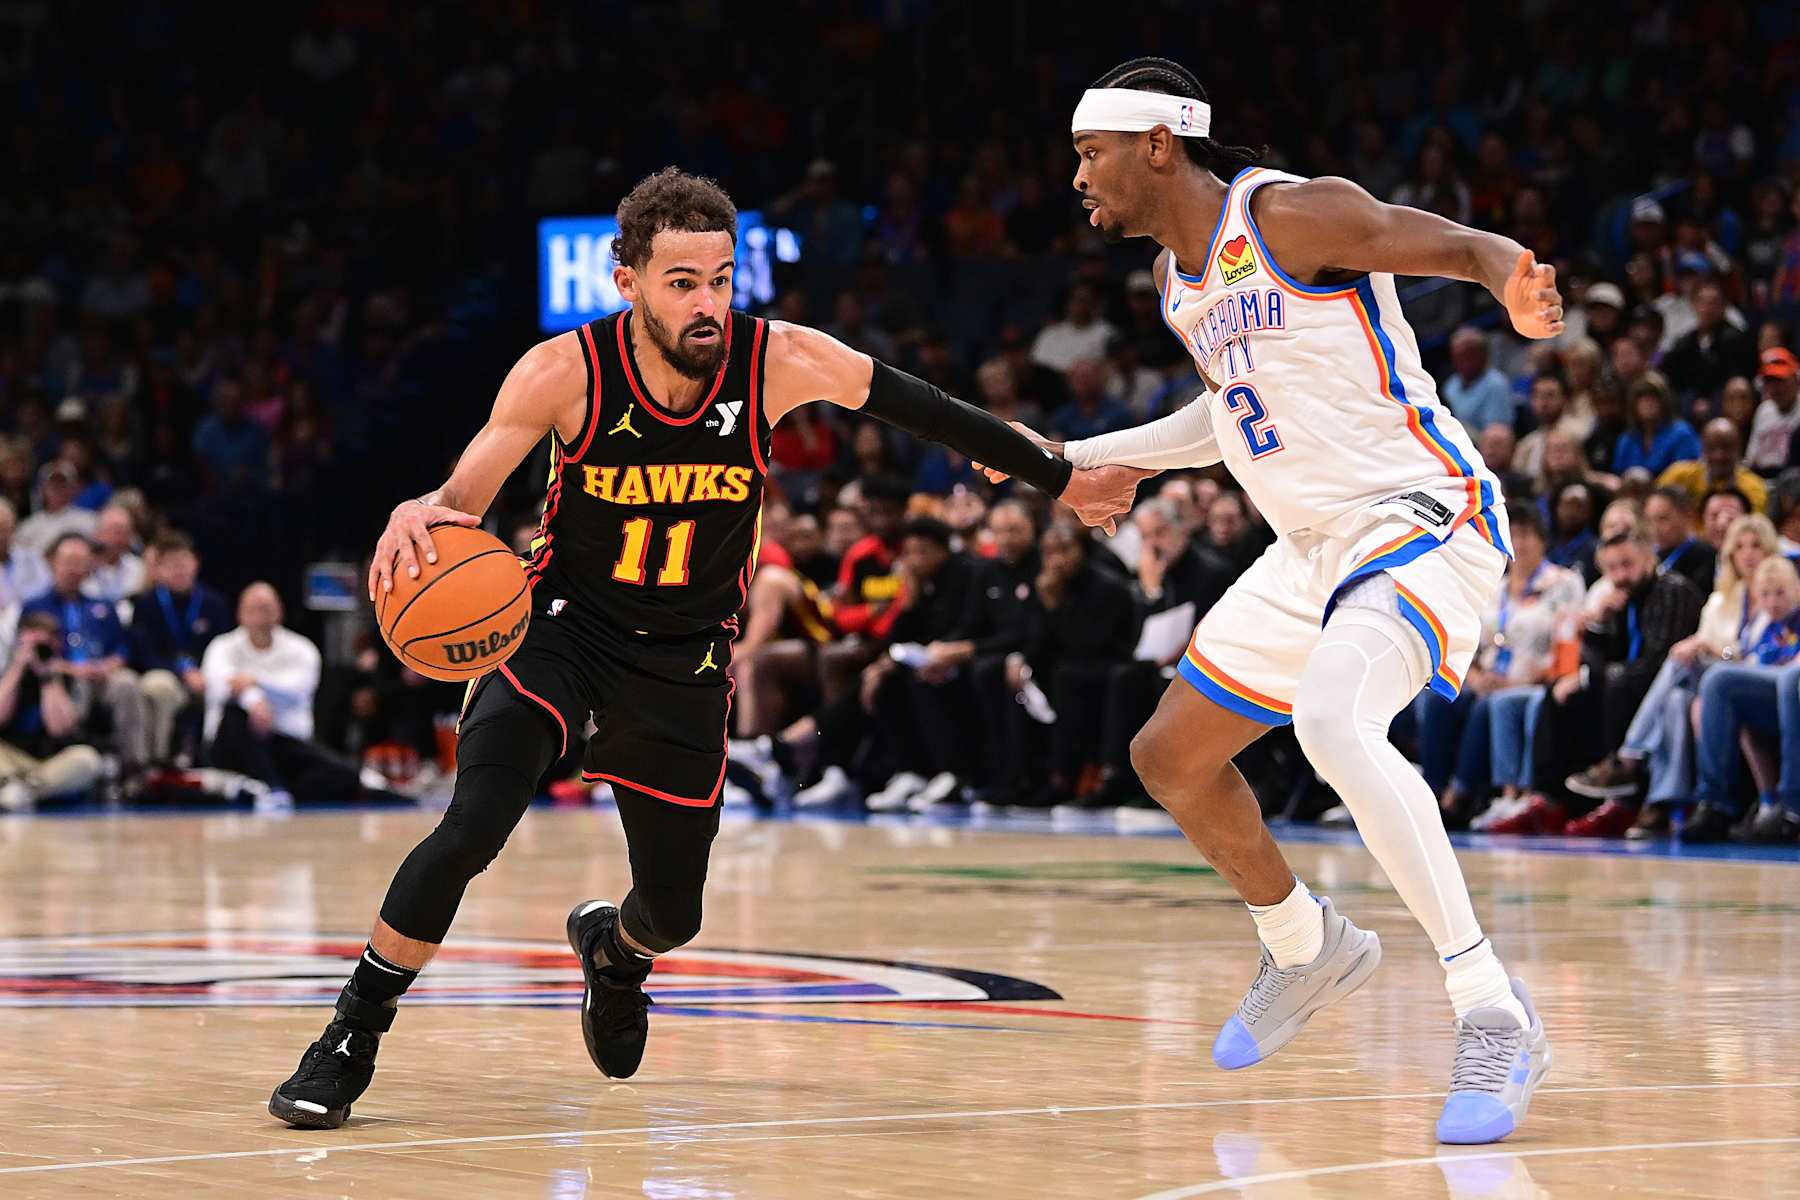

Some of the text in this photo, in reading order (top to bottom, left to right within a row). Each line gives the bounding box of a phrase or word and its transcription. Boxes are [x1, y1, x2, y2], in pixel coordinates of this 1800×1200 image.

[1190, 288, 1285, 374] KLAHOMA
[705, 419, 720, 428] the
[1223, 382, 1285, 461] 2
[582, 463, 754, 506] HAWKS
[611, 516, 697, 587] 11
[441, 610, 530, 665] Wilson
